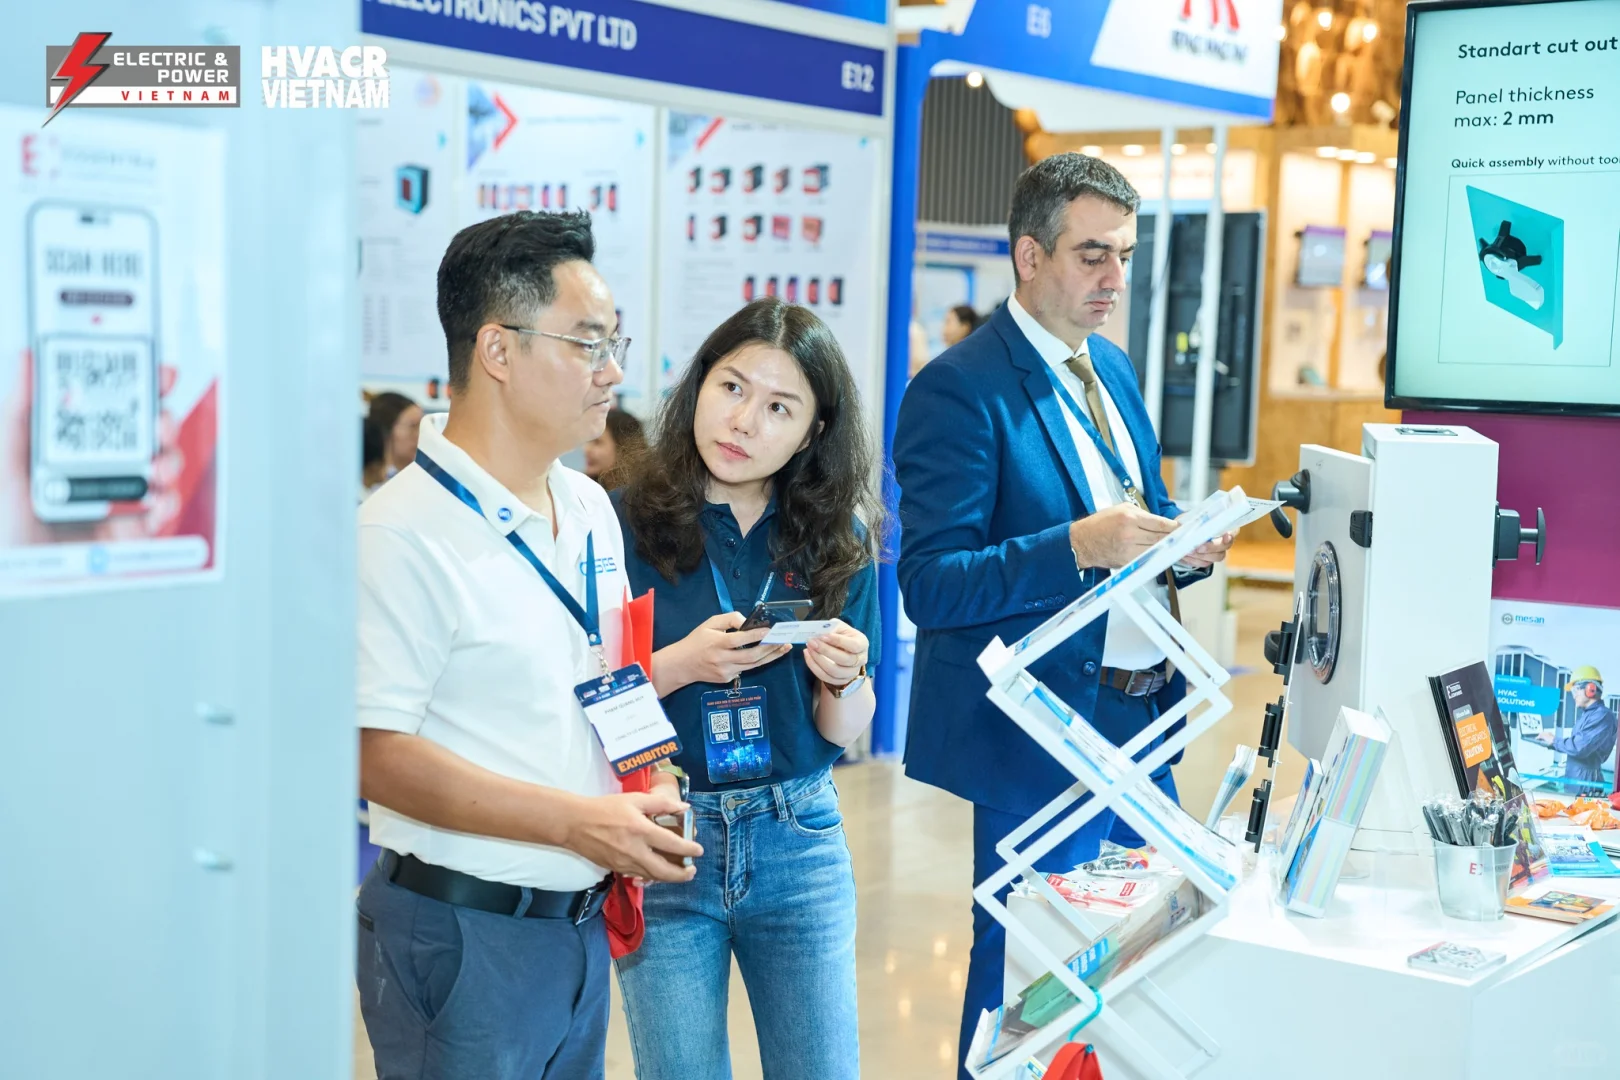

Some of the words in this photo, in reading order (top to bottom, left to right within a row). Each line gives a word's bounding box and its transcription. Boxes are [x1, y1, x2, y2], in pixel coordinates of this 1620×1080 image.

[549, 5, 596, 43] PVT
[597, 14, 638, 51] LTD
[1458, 40, 1541, 60] Standart
[1546, 39, 1579, 55] cut
[1584, 36, 1619, 52] out
[841, 61, 874, 92] E12
[1455, 88, 1503, 105] Panel
[1508, 85, 1595, 103] thickness
[1454, 113, 1498, 128] max:
[1502, 111, 1514, 126] 2
[1518, 112, 1554, 126] mm
[1451, 157, 1485, 170] Quick
[1489, 156, 1545, 171] assembly
[1547, 154, 1596, 167] without
[1598, 155, 1620, 165] too
[1515, 614, 1545, 624] mesan
[1497, 689, 1517, 697] HVAC
[1497, 697, 1536, 708] SOLUTIONS
[616, 741, 679, 773] EXHIBITOR
